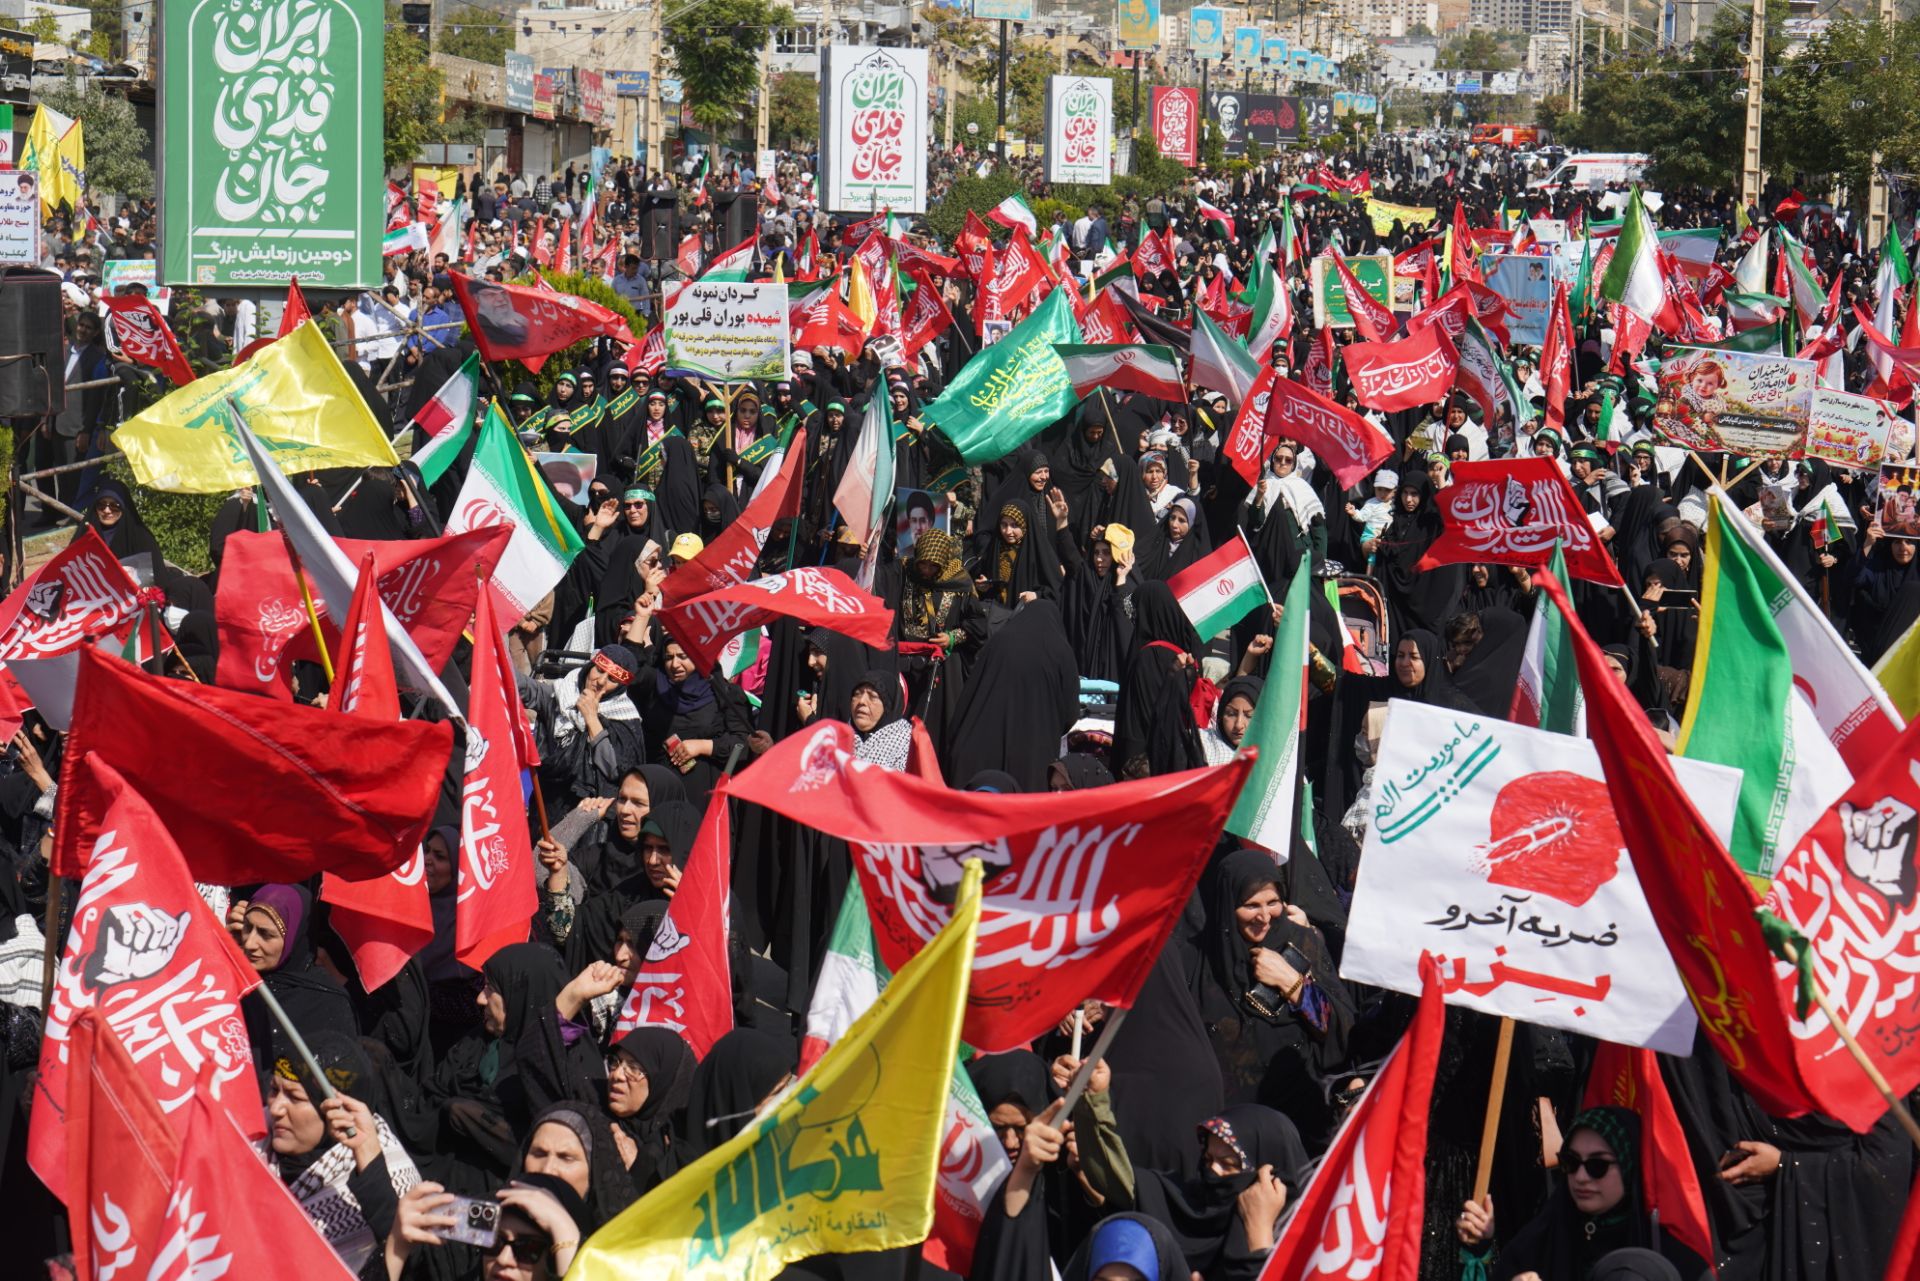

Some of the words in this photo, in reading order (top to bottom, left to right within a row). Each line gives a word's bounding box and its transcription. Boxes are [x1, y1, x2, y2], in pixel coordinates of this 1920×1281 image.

[213, 0, 332, 75] ایران
[852, 73, 904, 109] ایران
[213, 76, 334, 150] فدای
[1065, 93, 1097, 117] ایران
[851, 110, 905, 146] فدای
[1064, 117, 1098, 141] فدای
[851, 145, 903, 181] جان
[1064, 139, 1096, 164] جان
[214, 148, 330, 223] جان
[193, 241, 238, 264] بزرگ
[239, 242, 297, 266] رزمایش
[299, 248, 352, 266] دومین
[691, 285, 719, 303] نمونه
[718, 286, 760, 304] گردان
[671, 311, 689, 327] پور
[690, 307, 713, 326] قلی
[713, 309, 746, 329] پوران
[746, 310, 782, 328] شهیده
[1748, 363, 1780, 381] شهیدان
[1779, 363, 1791, 376] راه
[1518, 915, 1619, 948] ضربه
[782, 1112, 884, 1213] حزب
